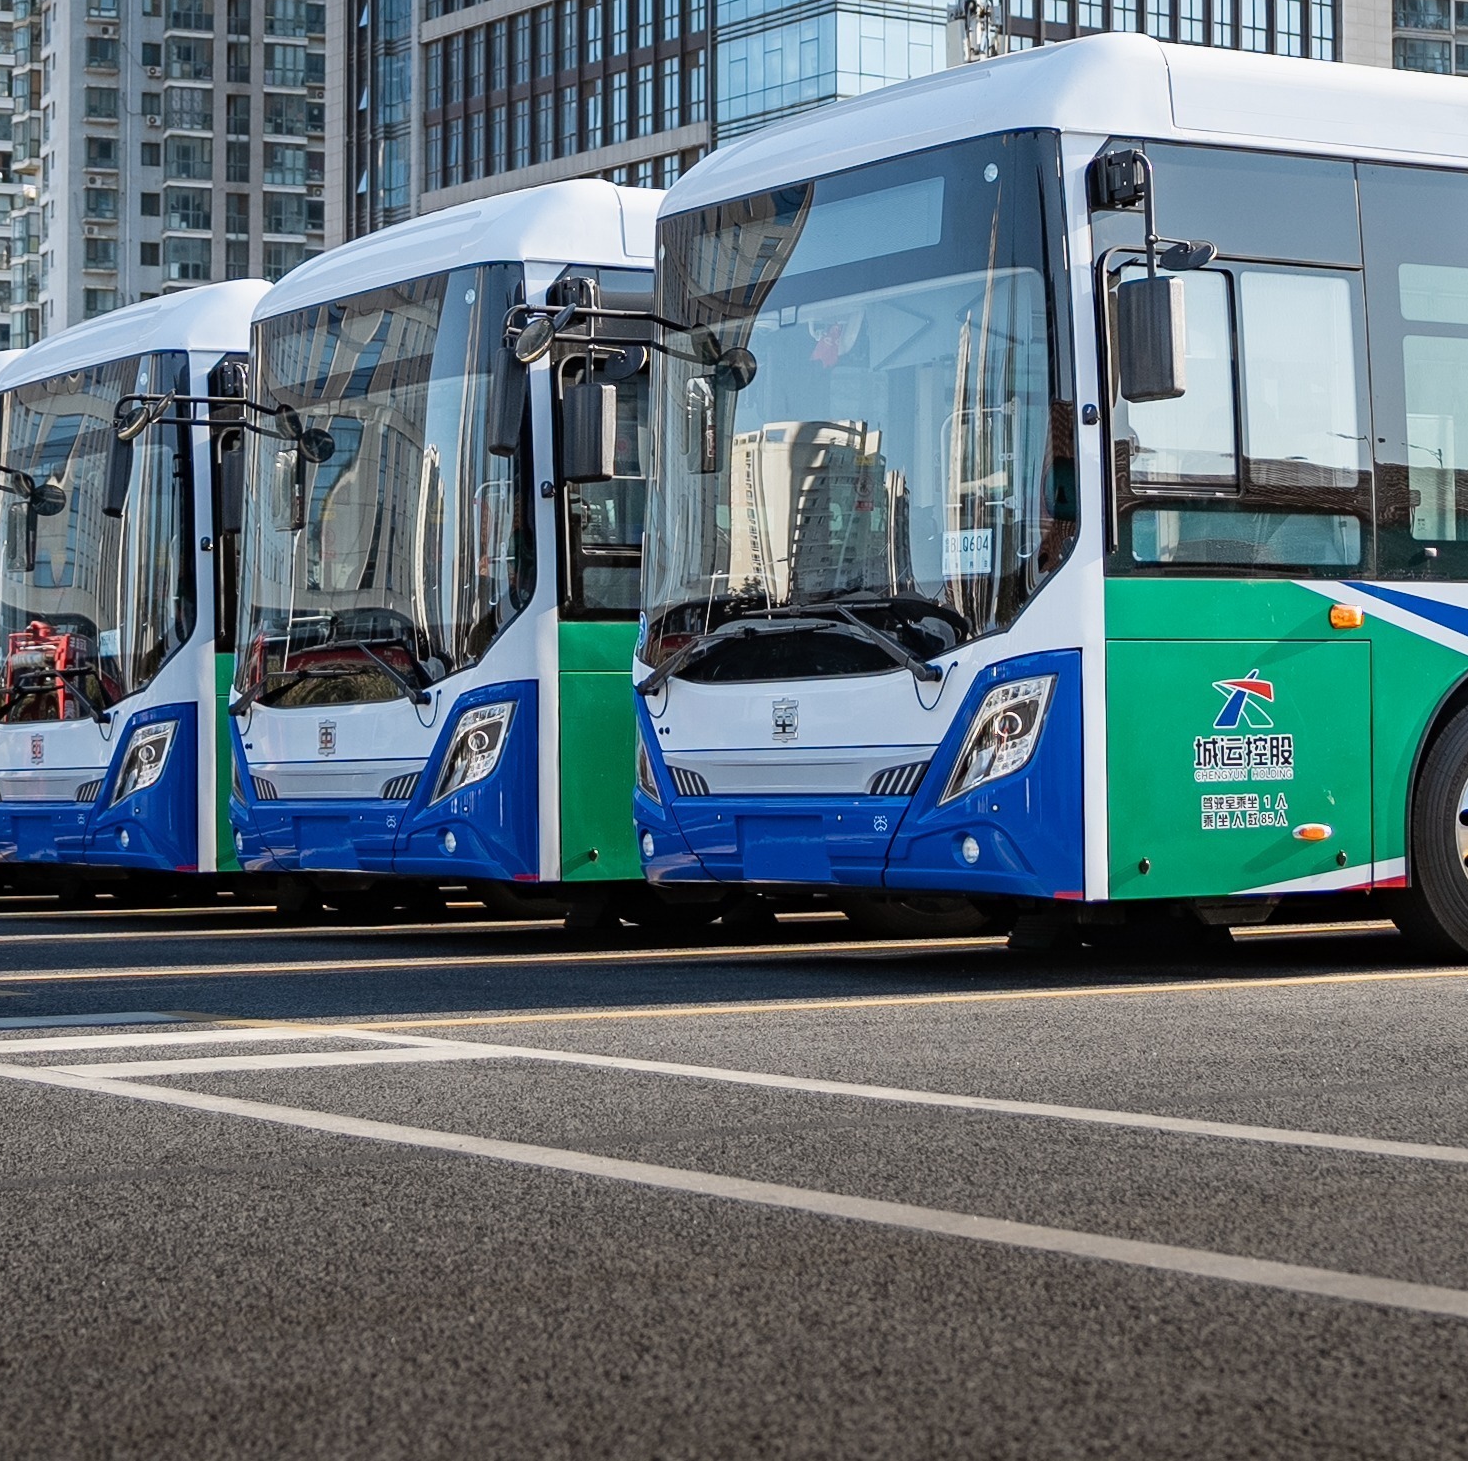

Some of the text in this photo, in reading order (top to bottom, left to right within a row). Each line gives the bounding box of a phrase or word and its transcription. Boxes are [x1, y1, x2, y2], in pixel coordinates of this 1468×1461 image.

[1194, 735, 1293, 768] 城运控股
[1194, 768, 1294, 782] CHENGYUN HOLDING
